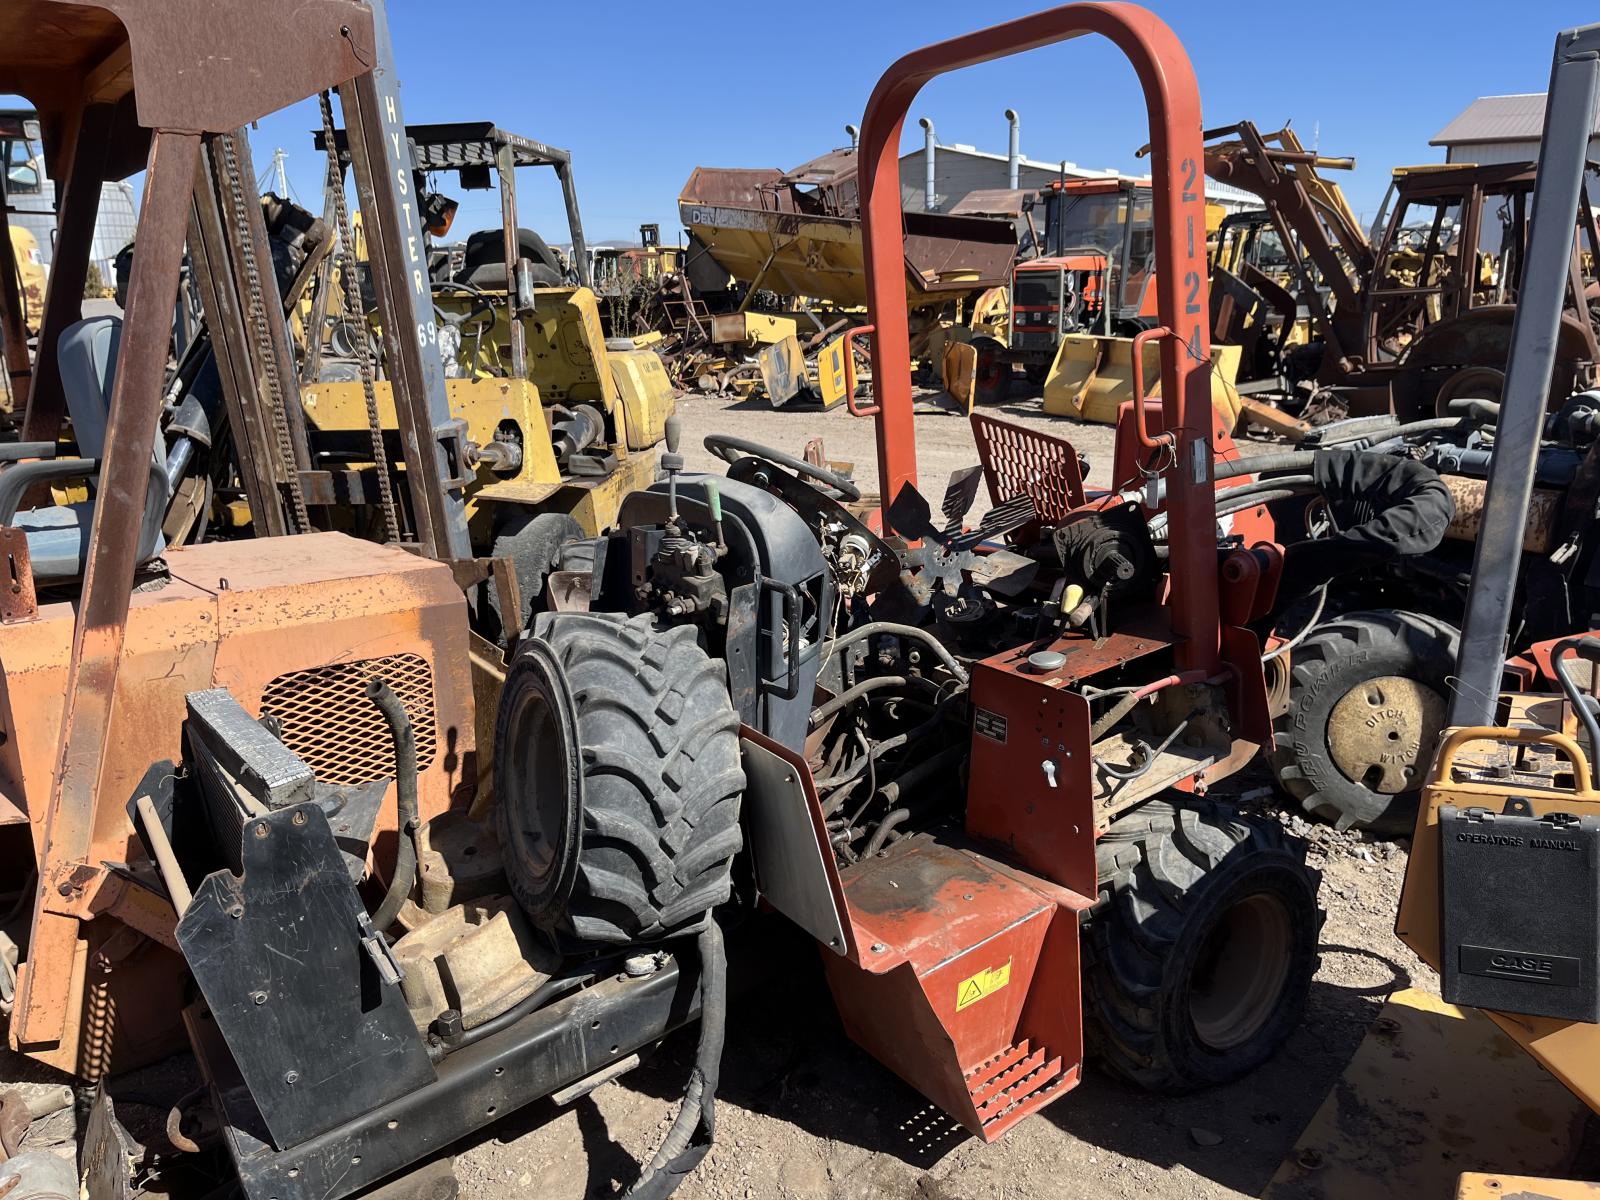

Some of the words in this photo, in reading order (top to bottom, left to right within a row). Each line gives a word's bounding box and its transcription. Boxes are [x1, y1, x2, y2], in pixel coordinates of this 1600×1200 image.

[385, 96, 424, 295] HYSTER
[417, 320, 436, 348] 69
[1365, 708, 1404, 730] DITCH
[1379, 740, 1421, 765] WITCH
[1456, 832, 1524, 847] OPERATORS
[1530, 838, 1582, 851] MANUAL
[1488, 954, 1553, 974] CASE
